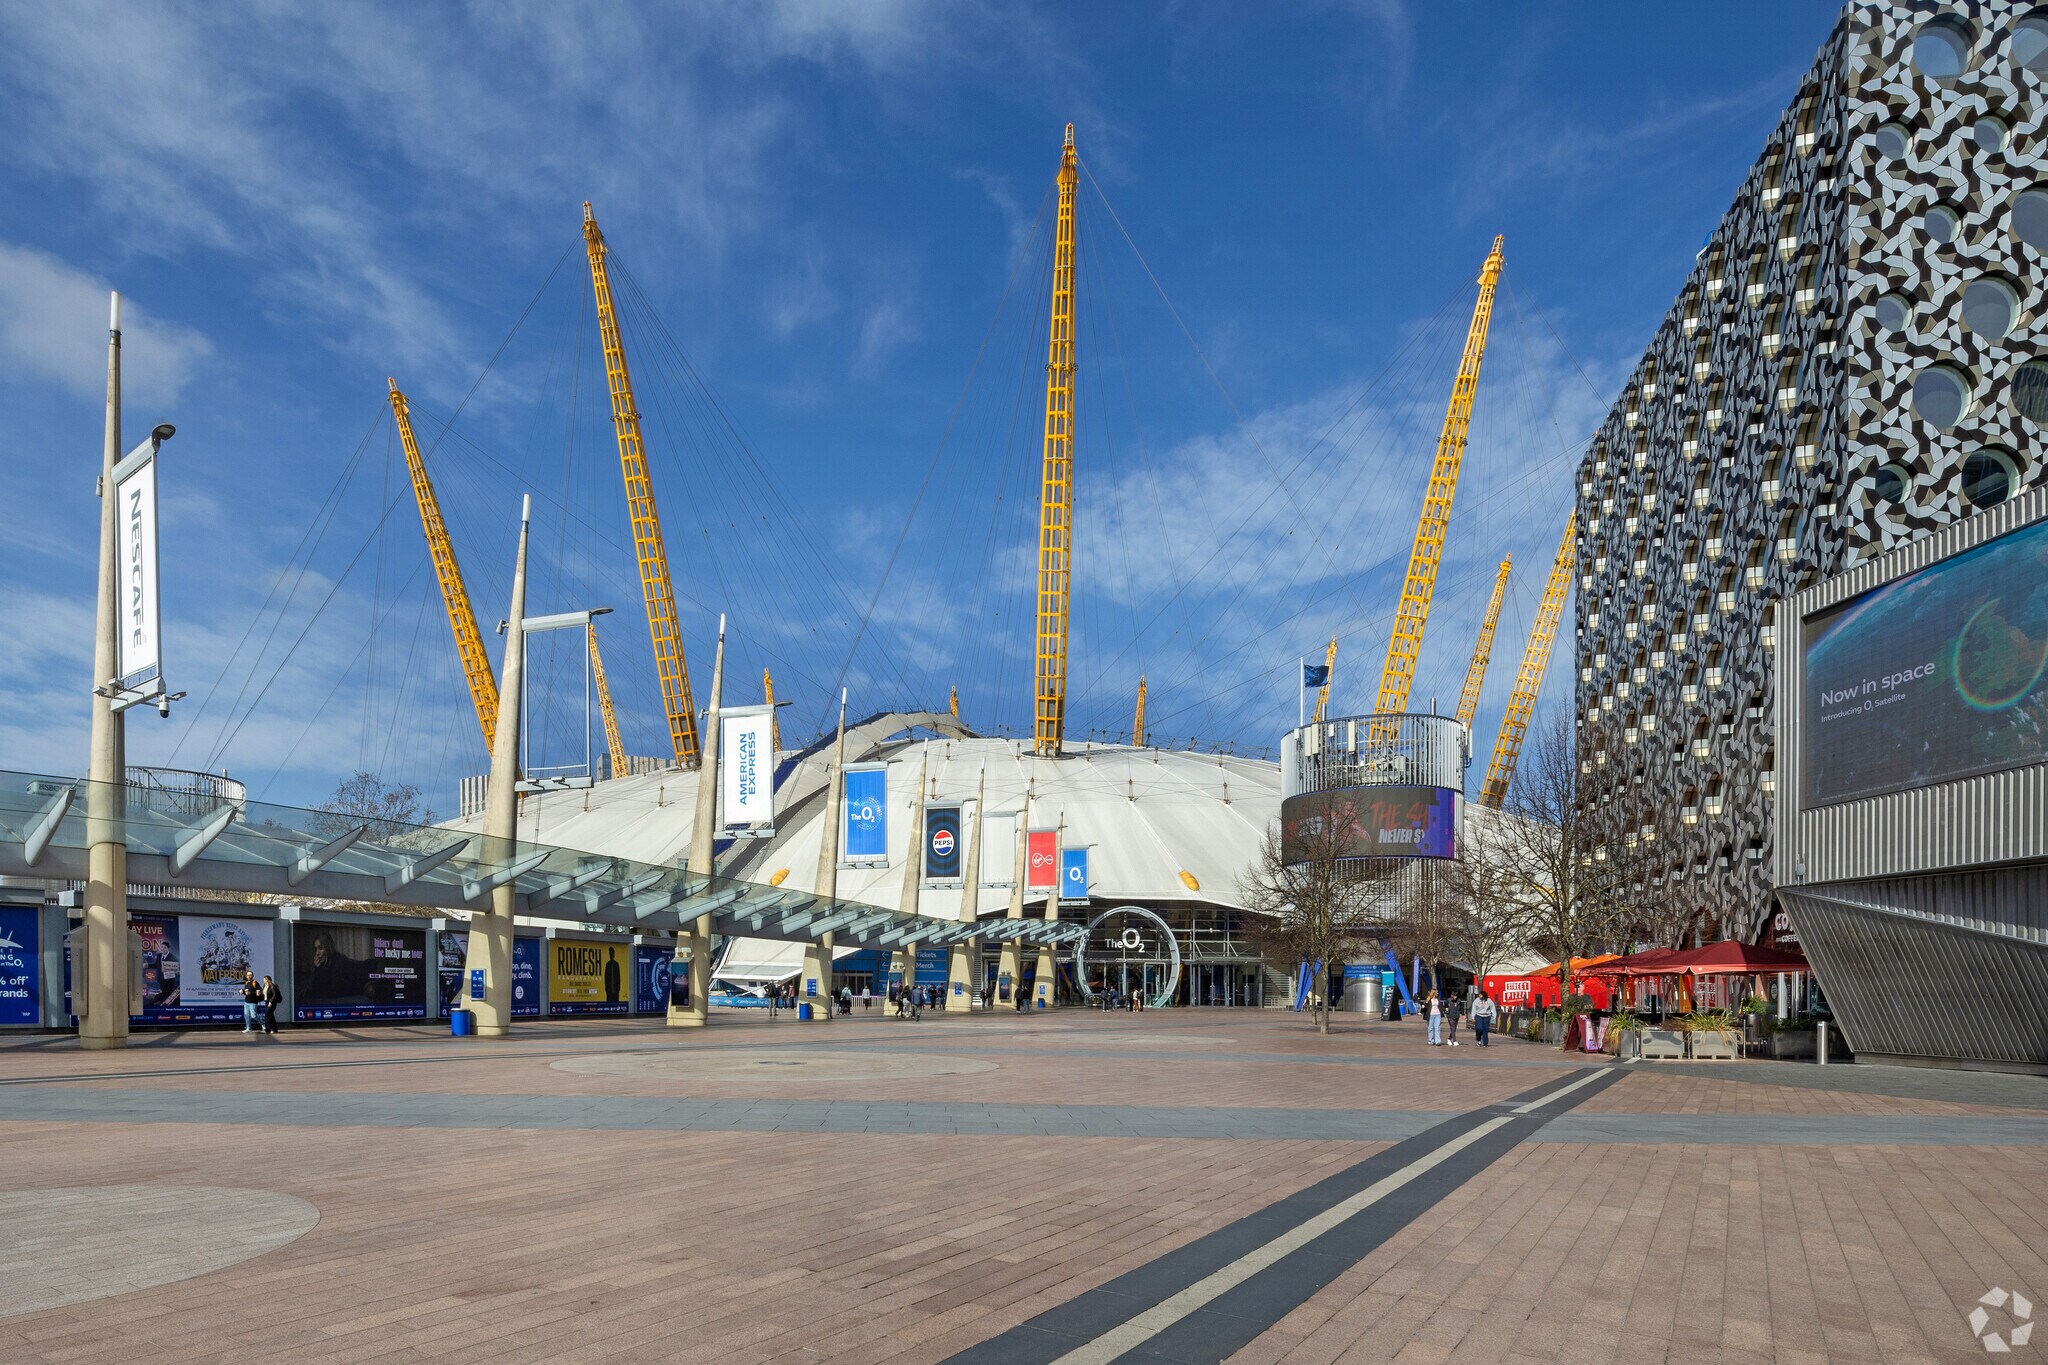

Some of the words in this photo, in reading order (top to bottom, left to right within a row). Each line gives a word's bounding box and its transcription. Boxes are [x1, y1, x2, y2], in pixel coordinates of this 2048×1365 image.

[1821, 686, 1858, 707] Now
[1863, 679, 1876, 694] in
[1882, 662, 1935, 690] space
[1822, 706, 1862, 722] Introducing
[1875, 693, 1906, 707] Satellite
[1370, 802, 1402, 831] THE
[1378, 829, 1412, 843] NEVER
[144, 926, 162, 934] LIVE
[1774, 912, 1793, 931] CO
[1105, 938, 1122, 948] The
[1122, 928, 1145, 952] O2
[375, 948, 384, 958] the
[385, 949, 400, 959] lucky
[412, 950, 422, 958] tour
[558, 946, 602, 976] ROMESH
[202, 970, 246, 981] WATERBOY
[521, 962, 532, 970] dine,
